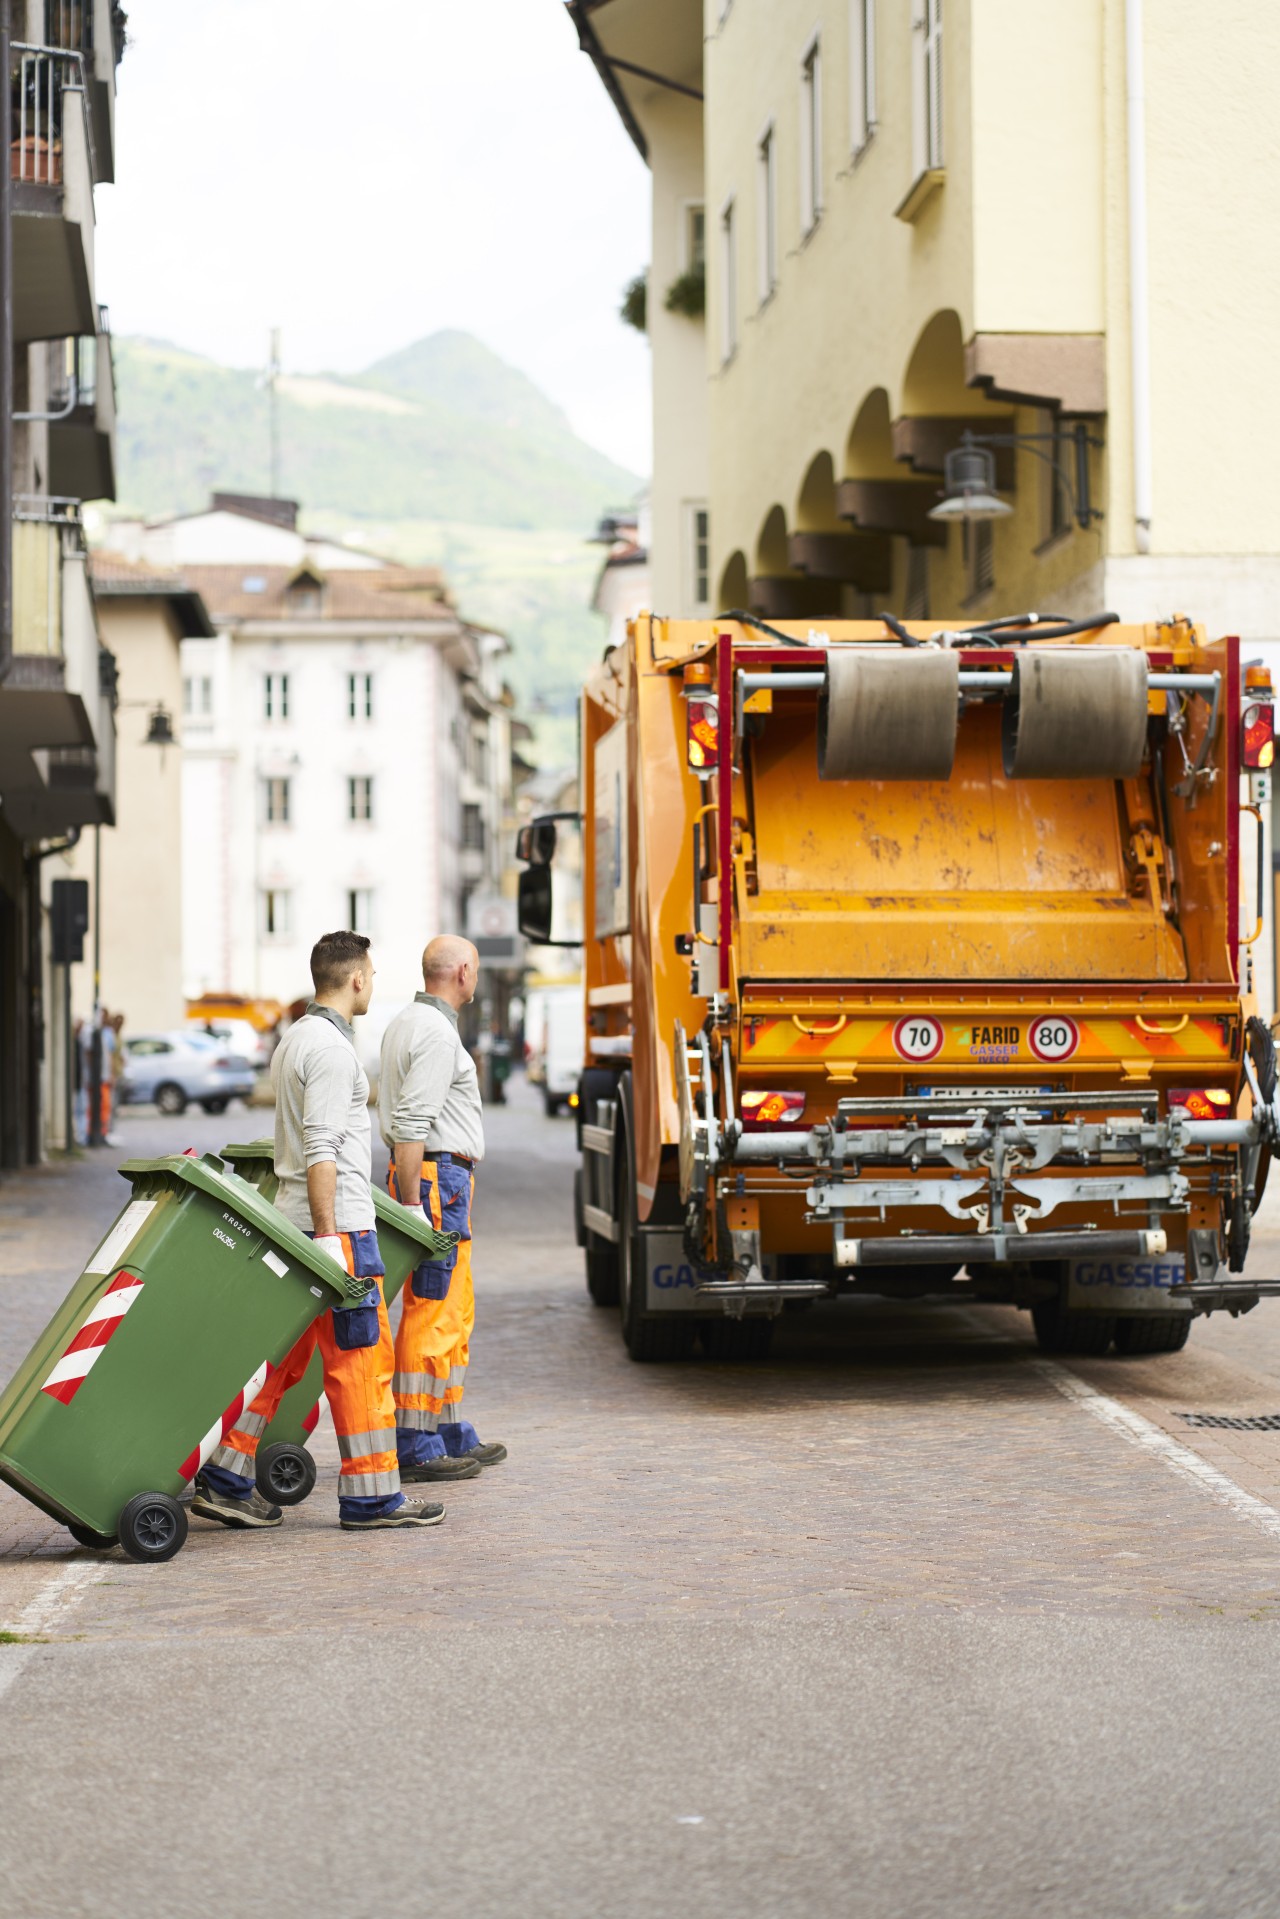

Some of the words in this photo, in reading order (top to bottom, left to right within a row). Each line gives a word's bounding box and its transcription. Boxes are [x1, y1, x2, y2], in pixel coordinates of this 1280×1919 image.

[909, 1027, 931, 1047] 70
[971, 1026, 1020, 1045] FARID
[1039, 1026, 1068, 1046] 80
[969, 1045, 1019, 1055] GASSER
[978, 1055, 1010, 1064] IVECO
[222, 1212, 252, 1237] RR0240
[212, 1228, 237, 1250] 004354
